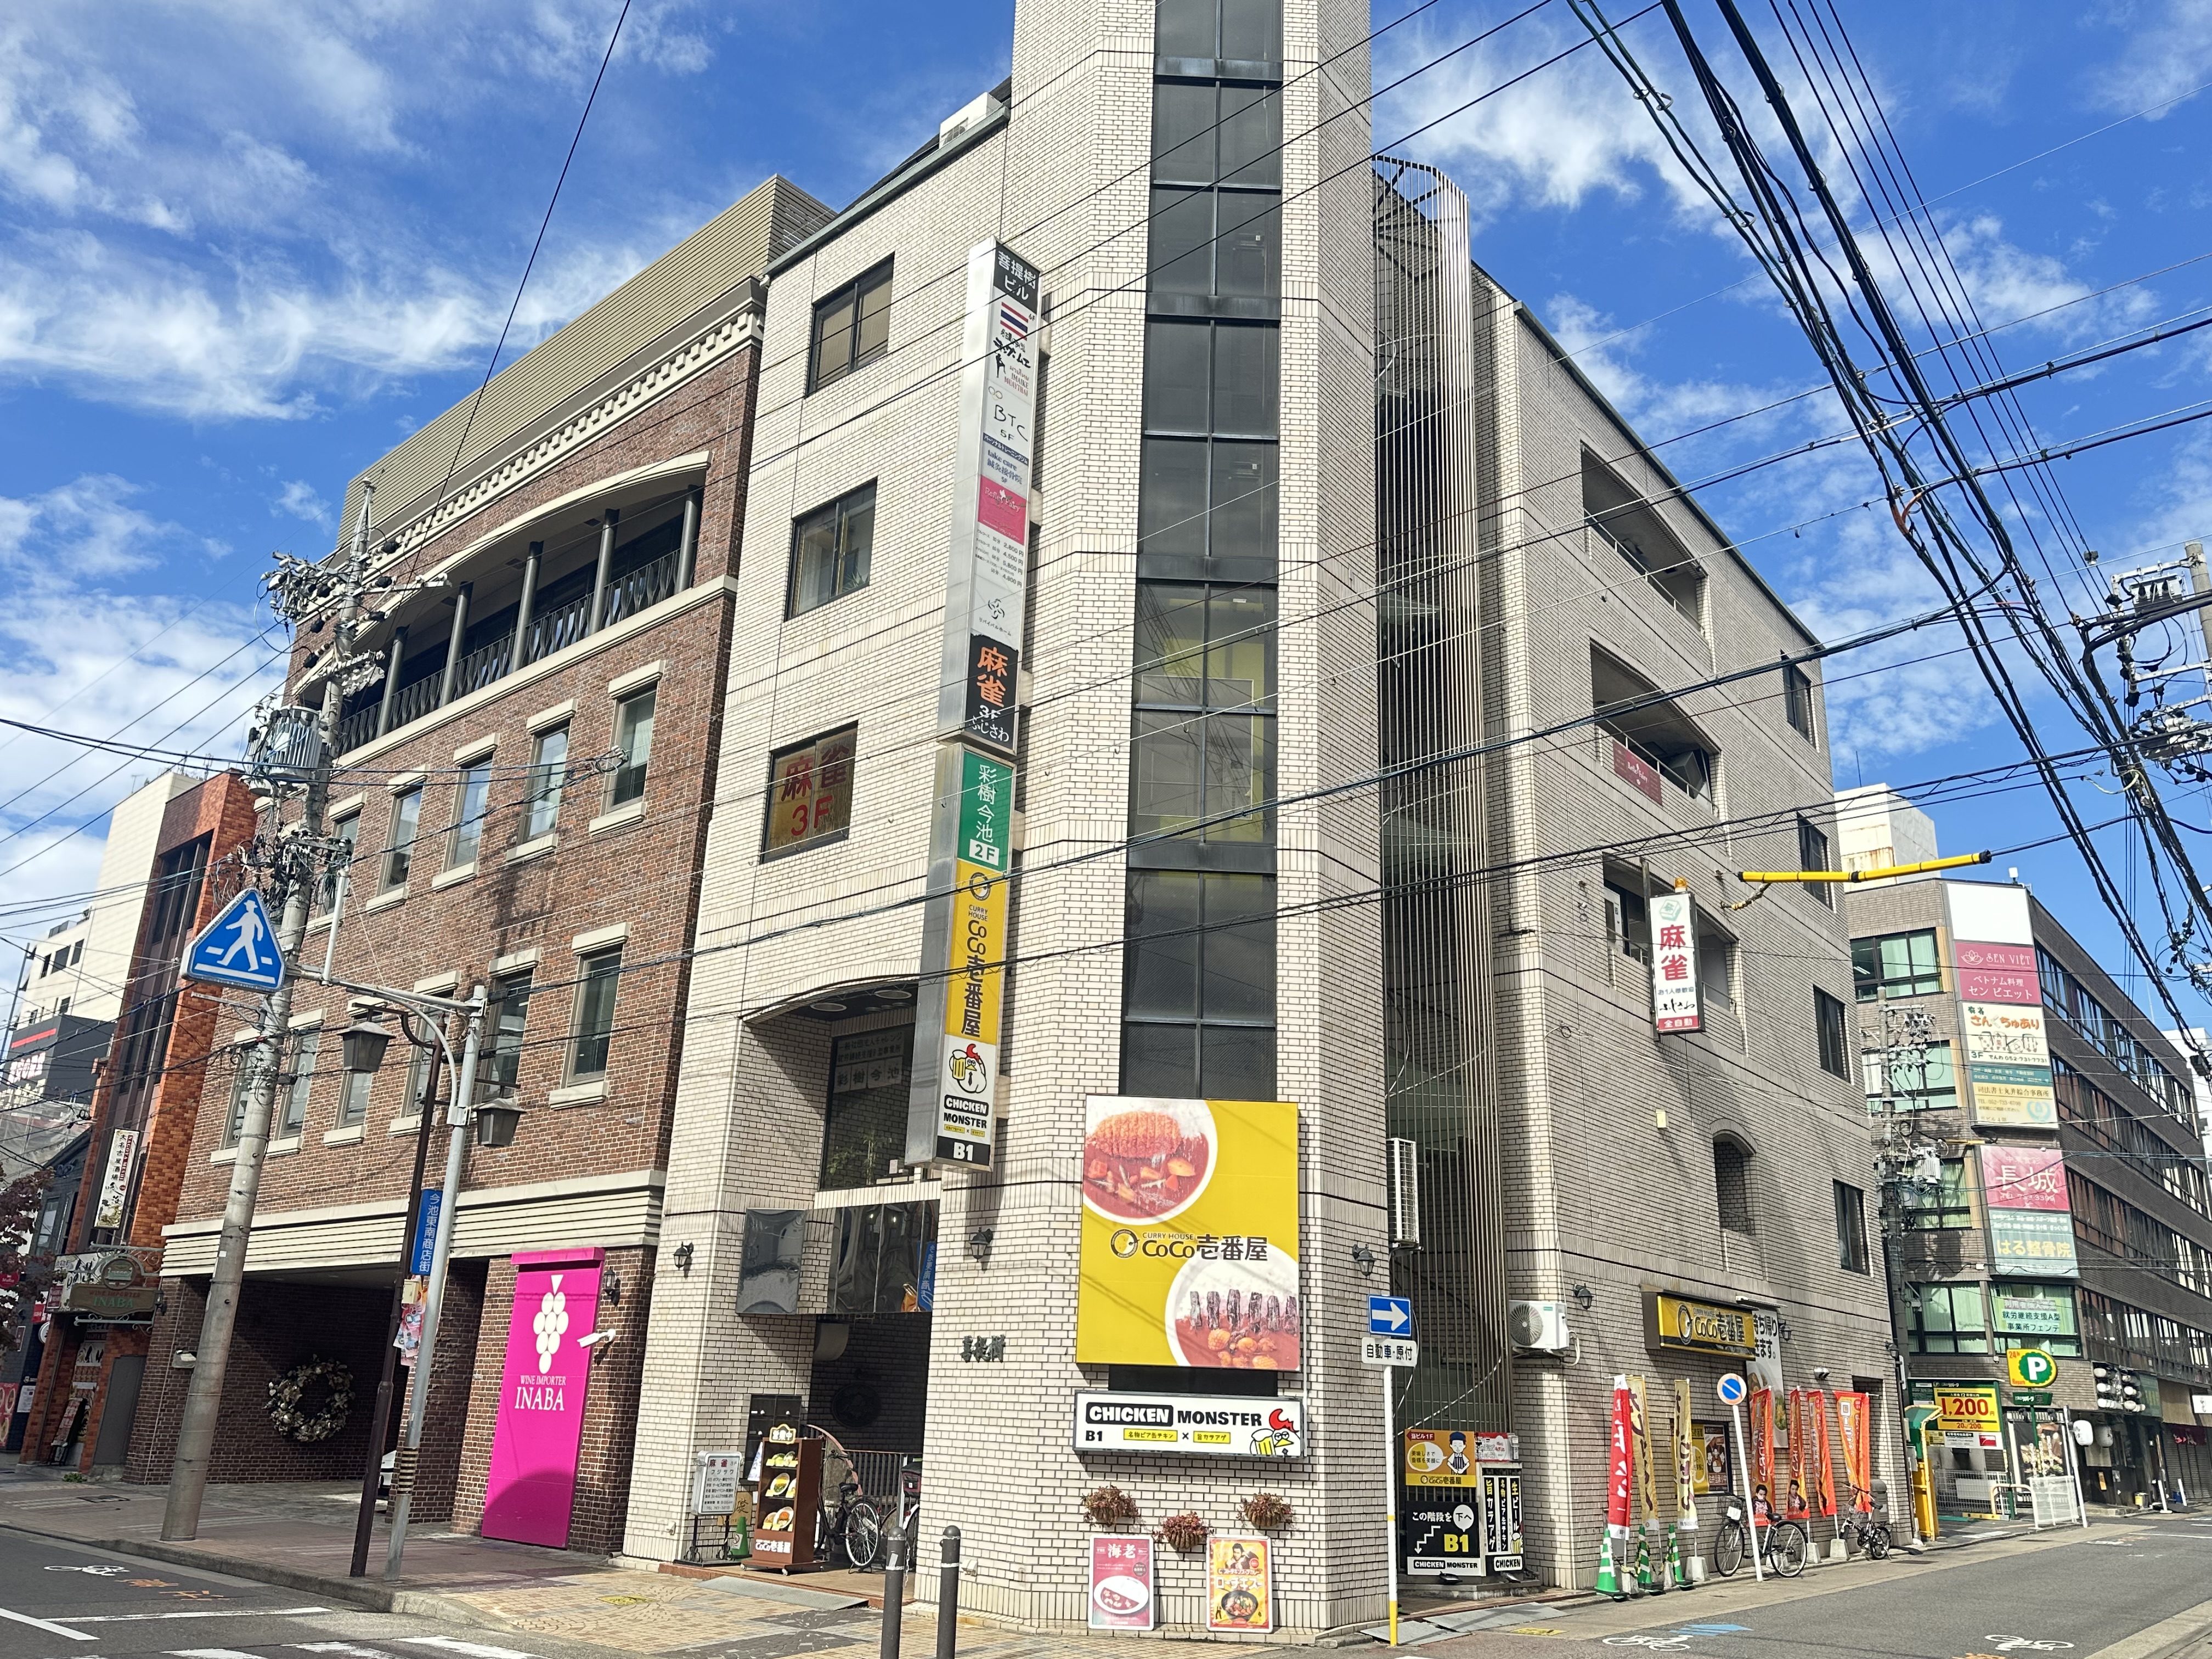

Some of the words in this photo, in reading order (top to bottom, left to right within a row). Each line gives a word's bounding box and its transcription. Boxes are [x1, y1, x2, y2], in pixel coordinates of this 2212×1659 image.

[997, 251, 1036, 289] 菩提樹
[1004, 275, 1029, 301] ビル
[1004, 376, 1028, 397] MUAYTHAI
[1012, 373, 1029, 389] IMAIKE
[994, 405, 1028, 442] BTC
[1000, 429, 1014, 441] 5F
[988, 450, 1002, 462] take
[1003, 460, 1017, 471] care
[977, 646, 1008, 708] 麻雀
[979, 704, 1001, 722] 3F
[969, 715, 1009, 742] ふじさわ
[781, 743, 850, 802] 麻雀
[976, 764, 997, 843] 彩樹今池
[791, 795, 833, 836] 3F
[975, 844, 995, 860] 2F
[968, 912, 988, 922] HOUSE
[969, 905, 988, 915] CURRY
[1660, 924, 1689, 981] 麻雀
[1986, 953, 2005, 963] SEN
[1973, 975, 2024, 987] ベトナム料理
[1968, 986, 1989, 996] セン
[1994, 988, 2032, 1000] ビエット
[1663, 1018, 1693, 1028] 全自動
[946, 1097, 986, 1115] CHICKEN
[944, 1113, 987, 1129] MONSTER
[953, 1142, 973, 1161] B1
[1996, 1165, 2058, 1193] 長城
[419, 1193, 441, 1272] 今池東南商店街
[1142, 1234, 1268, 1261] CoCo壱番屋
[1997, 1239, 2072, 1258] はる整骨院
[93, 1297, 133, 1308] INABA
[2002, 1311, 2061, 1321] 就労継続支援A型
[1694, 1312, 1746, 1342] CoCo壱番屋
[2007, 1323, 2059, 1332] 事業所フェンテ
[1367, 1343, 1412, 1361] 自動車・原付
[2027, 1357, 2047, 1380] P
[520, 1375, 535, 1385] WINE
[536, 1375, 566, 1385] IMPORTER
[515, 1387, 565, 1411] INABA
[1941, 1398, 1989, 1416] 1,200
[1089, 1406, 1170, 1423] CHICKEN
[1177, 1410, 1262, 1426] MONSTER
[772, 1431, 793, 1441] 営業中
[1085, 1430, 1103, 1442] B1
[1128, 1431, 1174, 1440] 名物ビア缶チキン
[1197, 1433, 1226, 1441] 旨カラアゲ
[1412, 1511, 1452, 1522] この階段を
[1455, 1513, 1472, 1521] 下へ
[1486, 1480, 1496, 1550] 旨カラアゲ
[1108, 1543, 1136, 1559] 海老
[1444, 1533, 1469, 1552] B1
[1496, 1559, 1521, 1568] CHICKEN
